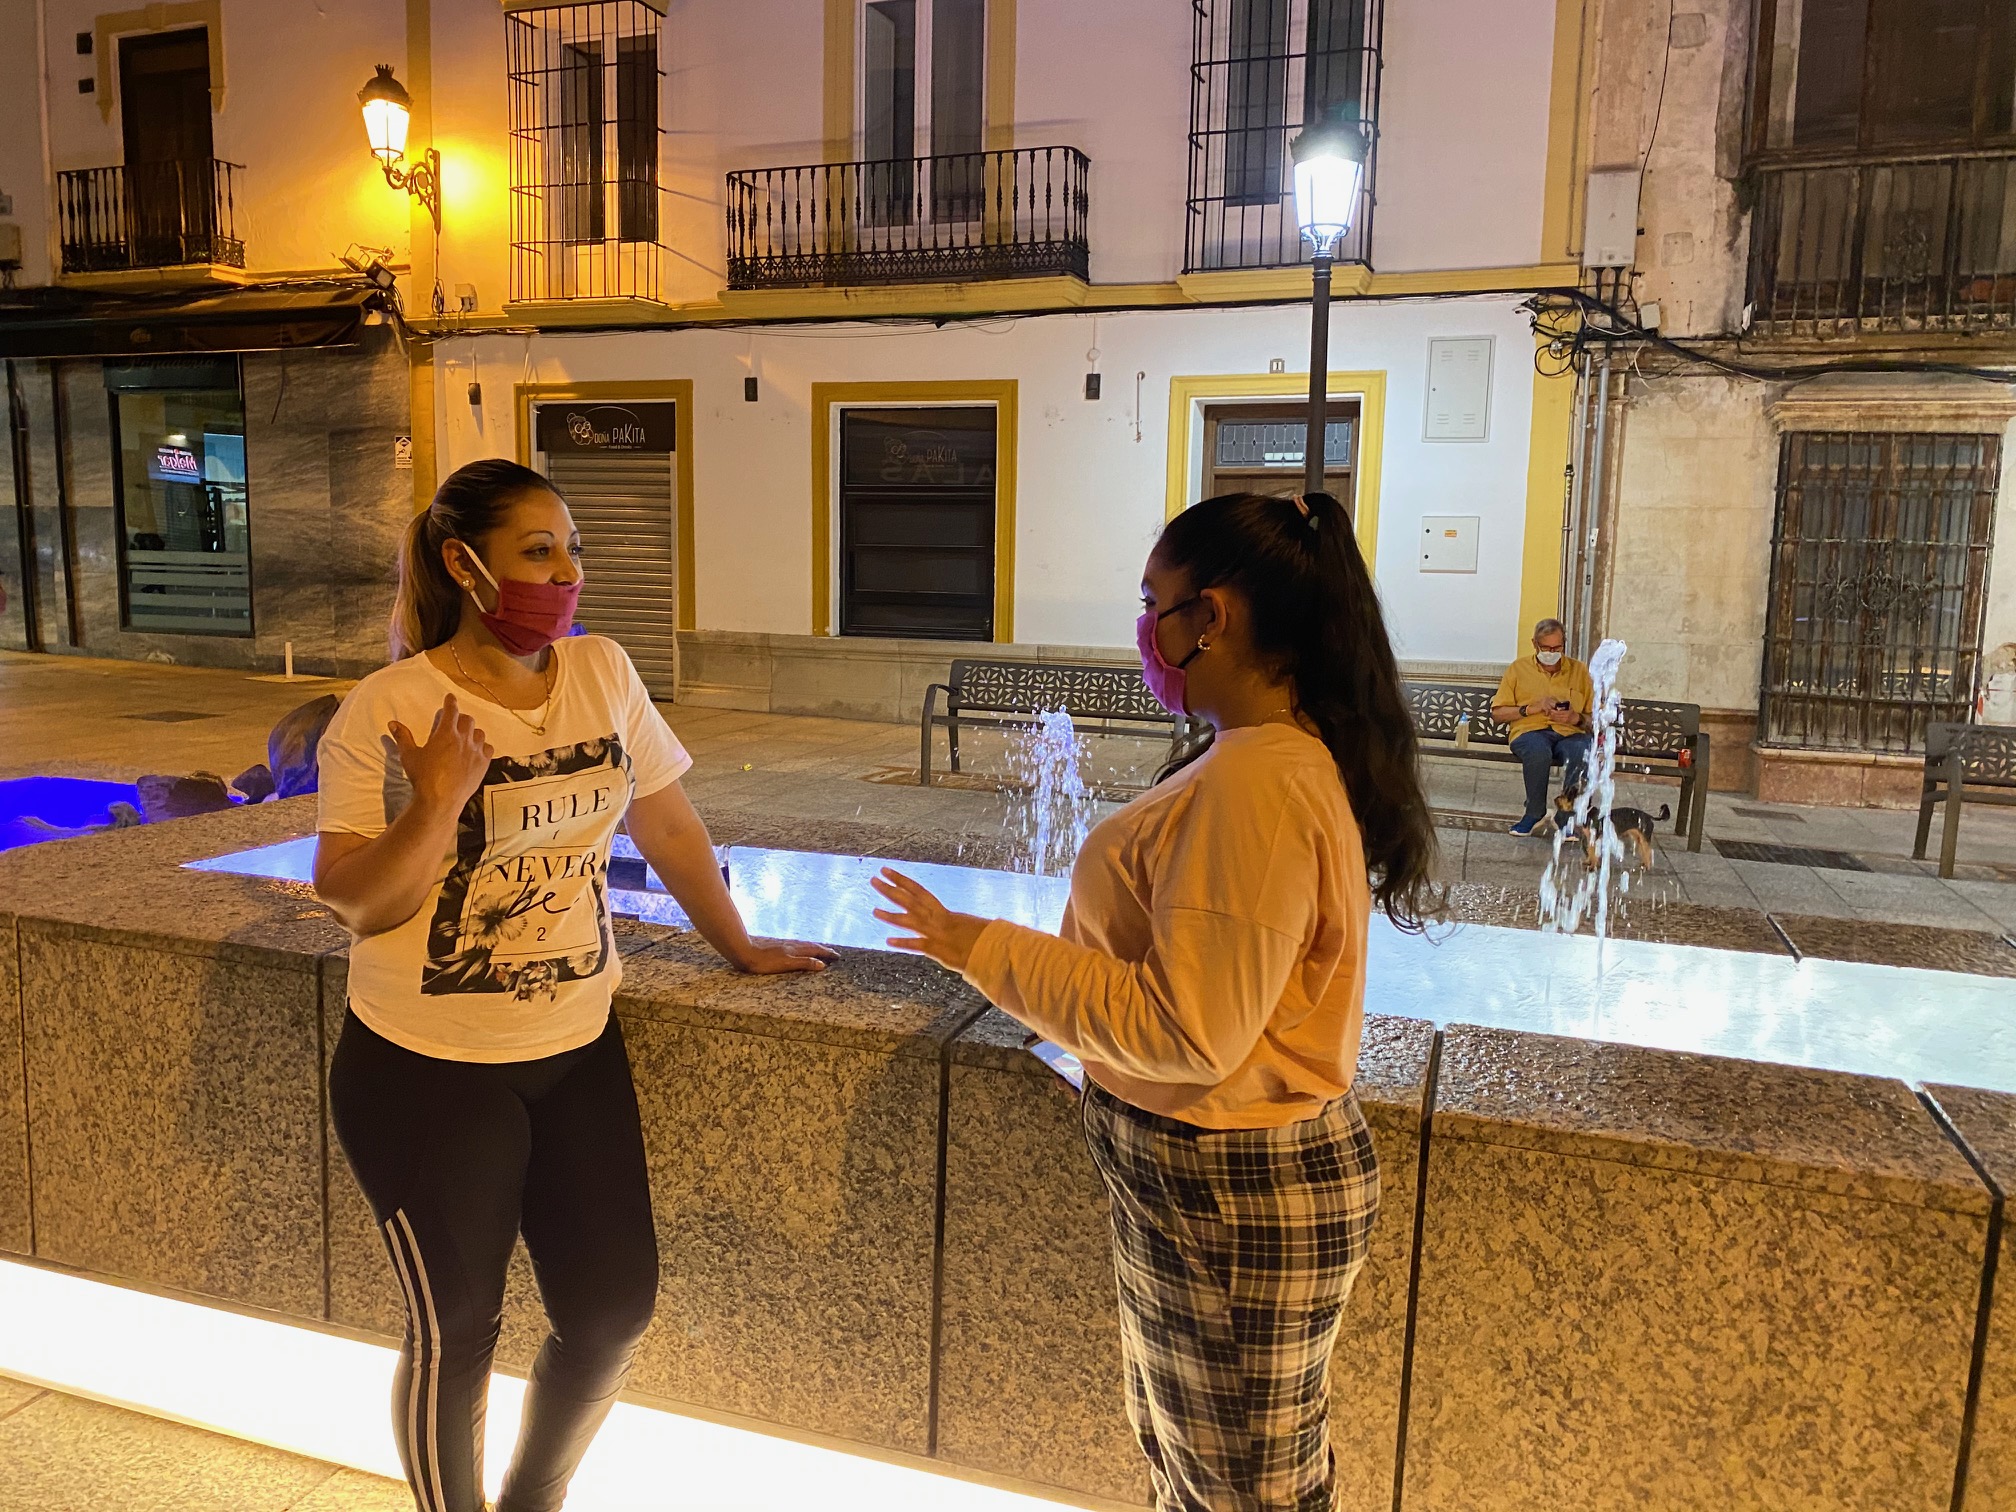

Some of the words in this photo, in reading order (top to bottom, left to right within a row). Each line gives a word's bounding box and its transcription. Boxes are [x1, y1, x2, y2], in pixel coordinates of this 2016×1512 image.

[520, 786, 610, 831] RULE
[486, 851, 597, 883] NEVER
[504, 874, 580, 919] be
[536, 926, 547, 942] 2
